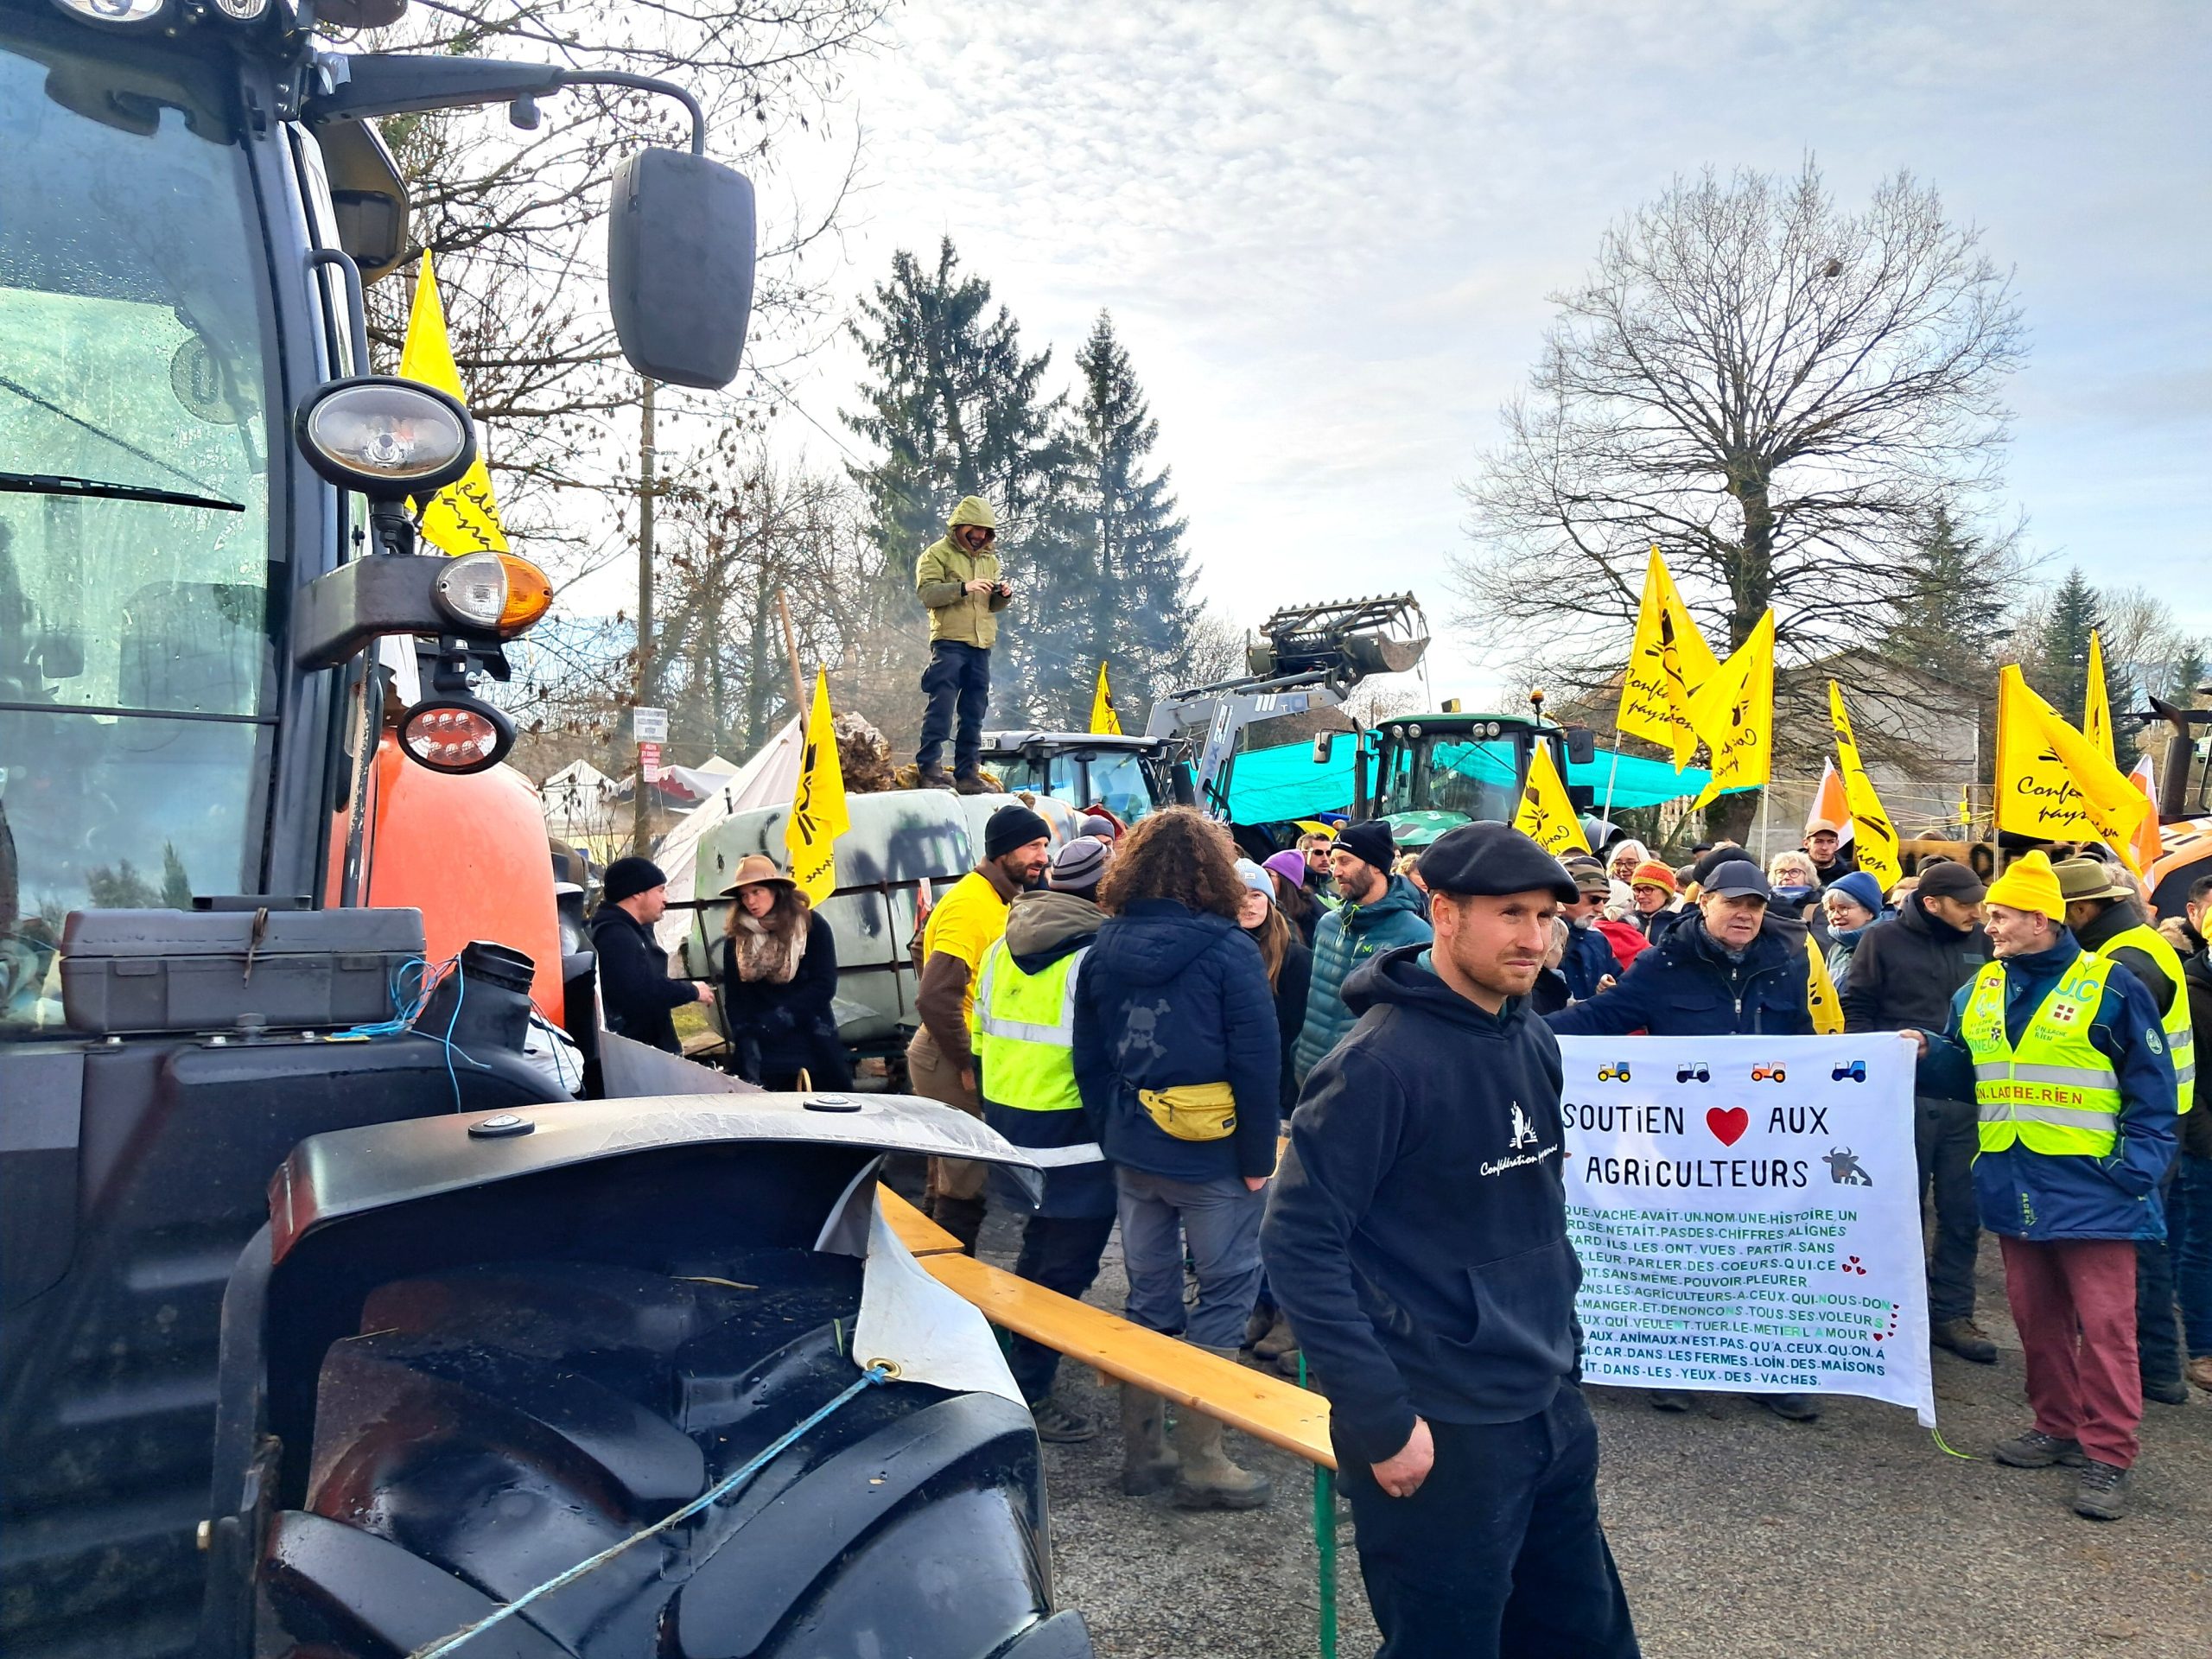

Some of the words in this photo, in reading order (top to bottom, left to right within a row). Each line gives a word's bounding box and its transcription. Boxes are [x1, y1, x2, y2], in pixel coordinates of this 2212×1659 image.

[1768, 1106, 1829, 1135] AUX
[1593, 1210, 1637, 1220] VACHE
[1685, 1212, 1702, 1223] UN
[1705, 1212, 1735, 1223] NOM
[1738, 1213, 1766, 1224] UNE
[1839, 1211, 1858, 1222] UN
[1633, 1243, 1658, 1253] LES
[1665, 1243, 1693, 1254] ONT
[1700, 1244, 1736, 1255] VUES
[1798, 1242, 1835, 1254] SANS
[1588, 1252, 1622, 1264] LEUR
[1628, 1257, 1682, 1270] PARLER
[1688, 1262, 1714, 1272] DES
[1720, 1258, 1780, 1271] COEURS
[1784, 1258, 1813, 1270] QUI
[1816, 1260, 1836, 1271] CE
[1602, 1268, 1637, 1281] SANS
[1685, 1276, 1742, 1287] POUVOIR
[1606, 1285, 1631, 1295] LES
[1736, 1291, 1746, 1300] A
[1750, 1290, 1786, 1302] CEUX
[1791, 1294, 1815, 1305] QUI
[1819, 1294, 1858, 1306] NOUS
[1583, 1299, 1638, 1313] MANGER
[1643, 1302, 1658, 1313] ET
[1749, 1306, 1784, 1319] TOUS
[1789, 1311, 1815, 1321] SES
[1818, 1311, 1885, 1329] VOLEURS
[1633, 1318, 1690, 1331] VEULENT
[1696, 1321, 1728, 1332] TUER
[1732, 1322, 1749, 1333] LE
[1754, 1324, 1801, 1336] METIER
[1588, 1331, 1613, 1341] AUX
[1719, 1338, 1745, 1350] PAS
[1787, 1343, 1824, 1354] CEUX
[1595, 1346, 1622, 1357] CAR
[1627, 1348, 1663, 1359] DANS
[1669, 1351, 1692, 1362] LES
[1694, 1352, 1748, 1366] FERMES
[1790, 1358, 1816, 1370] DES
[1603, 1363, 1640, 1376] DANS
[1648, 1367, 1672, 1378] LES
[1680, 1368, 1717, 1381] YEUX
[1725, 1372, 1751, 1383] DES
